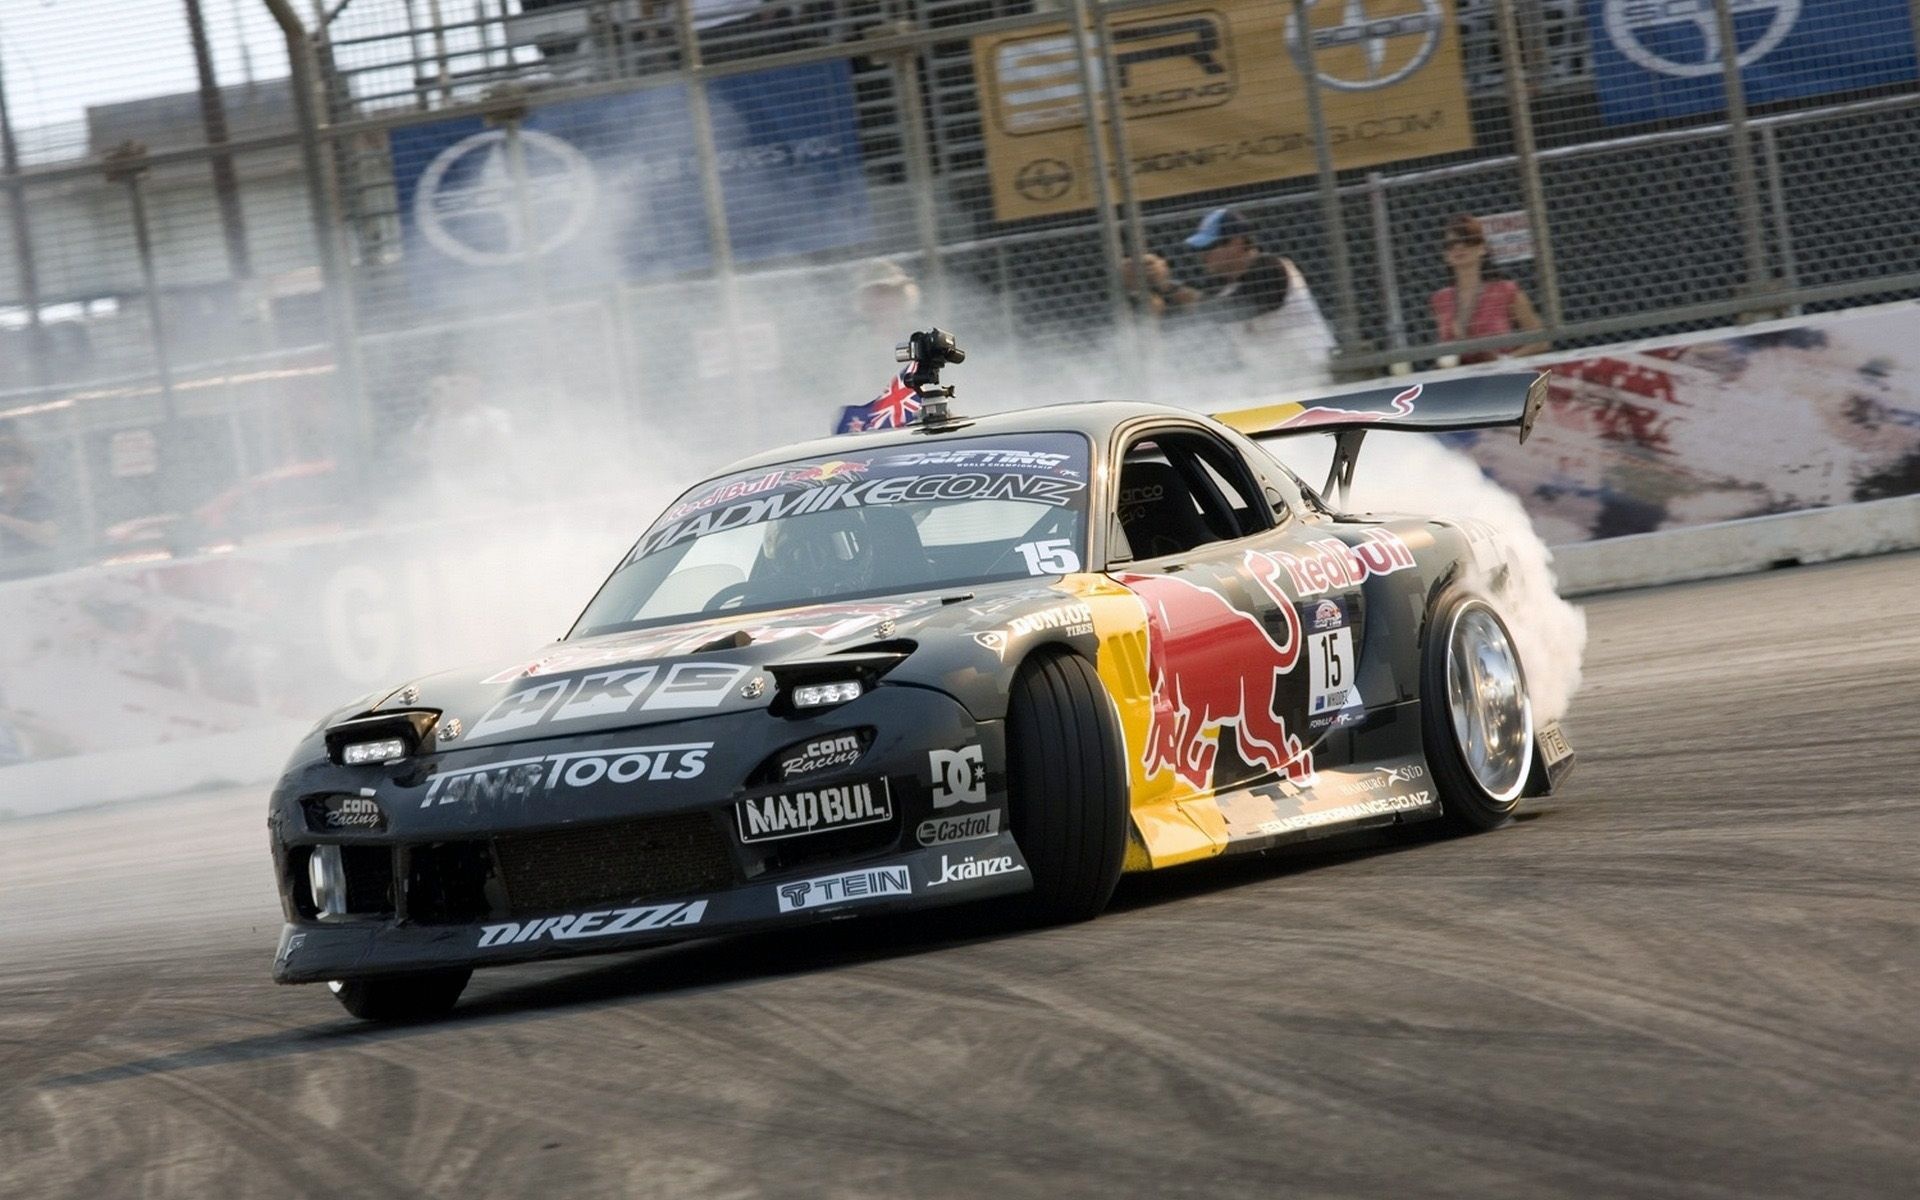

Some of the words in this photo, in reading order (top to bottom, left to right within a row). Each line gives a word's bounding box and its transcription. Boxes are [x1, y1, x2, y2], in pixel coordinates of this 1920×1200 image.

[888, 450, 1071, 468] DRIFTING
[1014, 538, 1081, 576] 15
[1006, 603, 1092, 637] DUNLOP
[1065, 622, 1094, 637] TIRES
[1320, 632, 1343, 690] 15
[465, 662, 752, 741] HKS
[801, 735, 858, 760] .com
[781, 750, 862, 778] Racing
[929, 744, 987, 809] DC
[1340, 776, 1387, 795] HAMBURG
[1401, 765, 1423, 782] SÜD
[326, 809, 381, 829] Racing
[339, 799, 379, 814] .com
[937, 813, 991, 842] Castrol
[814, 869, 908, 901] TEIN
[927, 854, 1024, 888] kränze
[477, 900, 709, 949] DIREZZA
